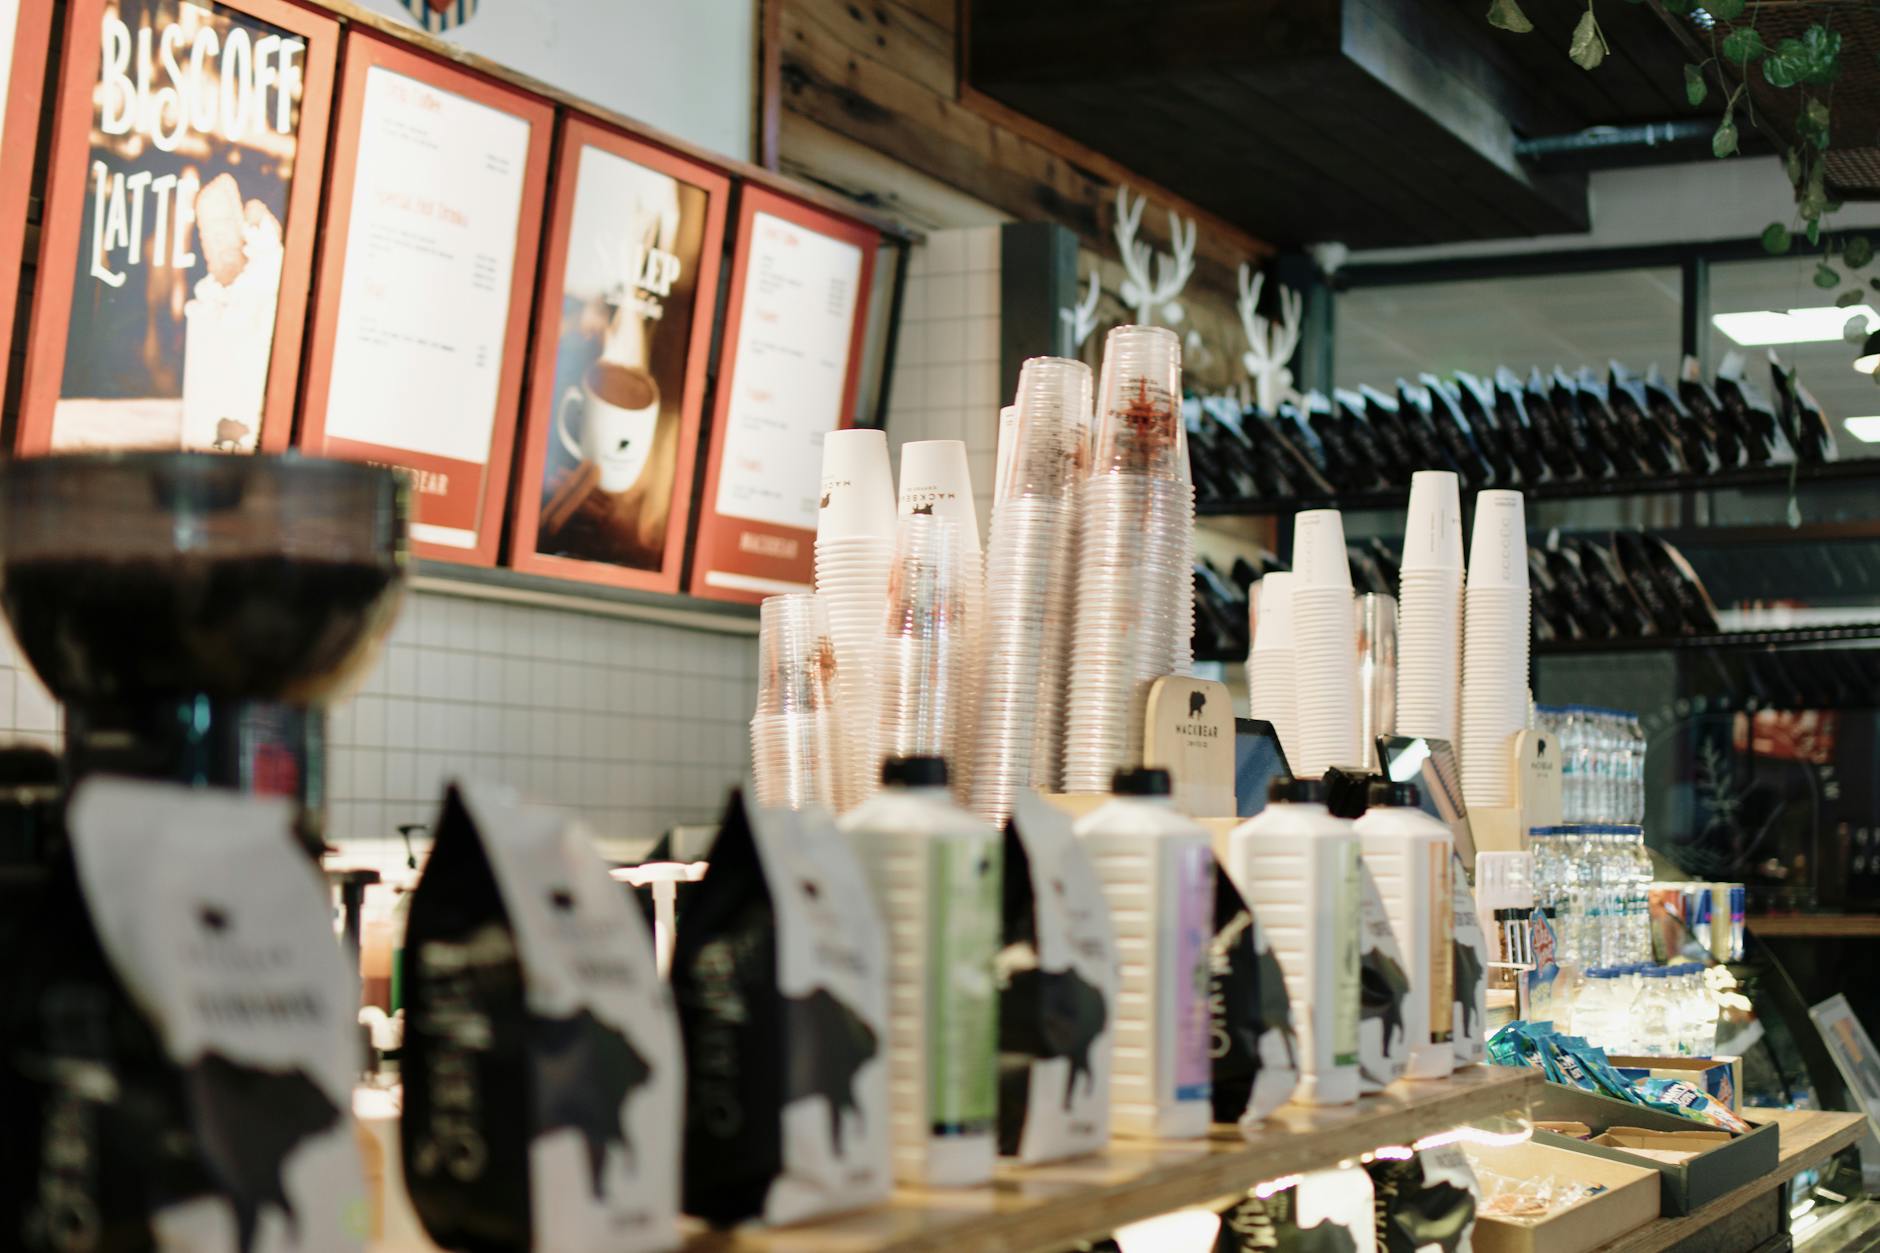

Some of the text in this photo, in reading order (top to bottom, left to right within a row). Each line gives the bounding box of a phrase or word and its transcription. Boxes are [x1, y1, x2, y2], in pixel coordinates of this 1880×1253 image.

[101, 18, 305, 151] BISCOFF
[91, 160, 200, 287] LATTE
[1176, 724, 1219, 738] MACKBEAR
